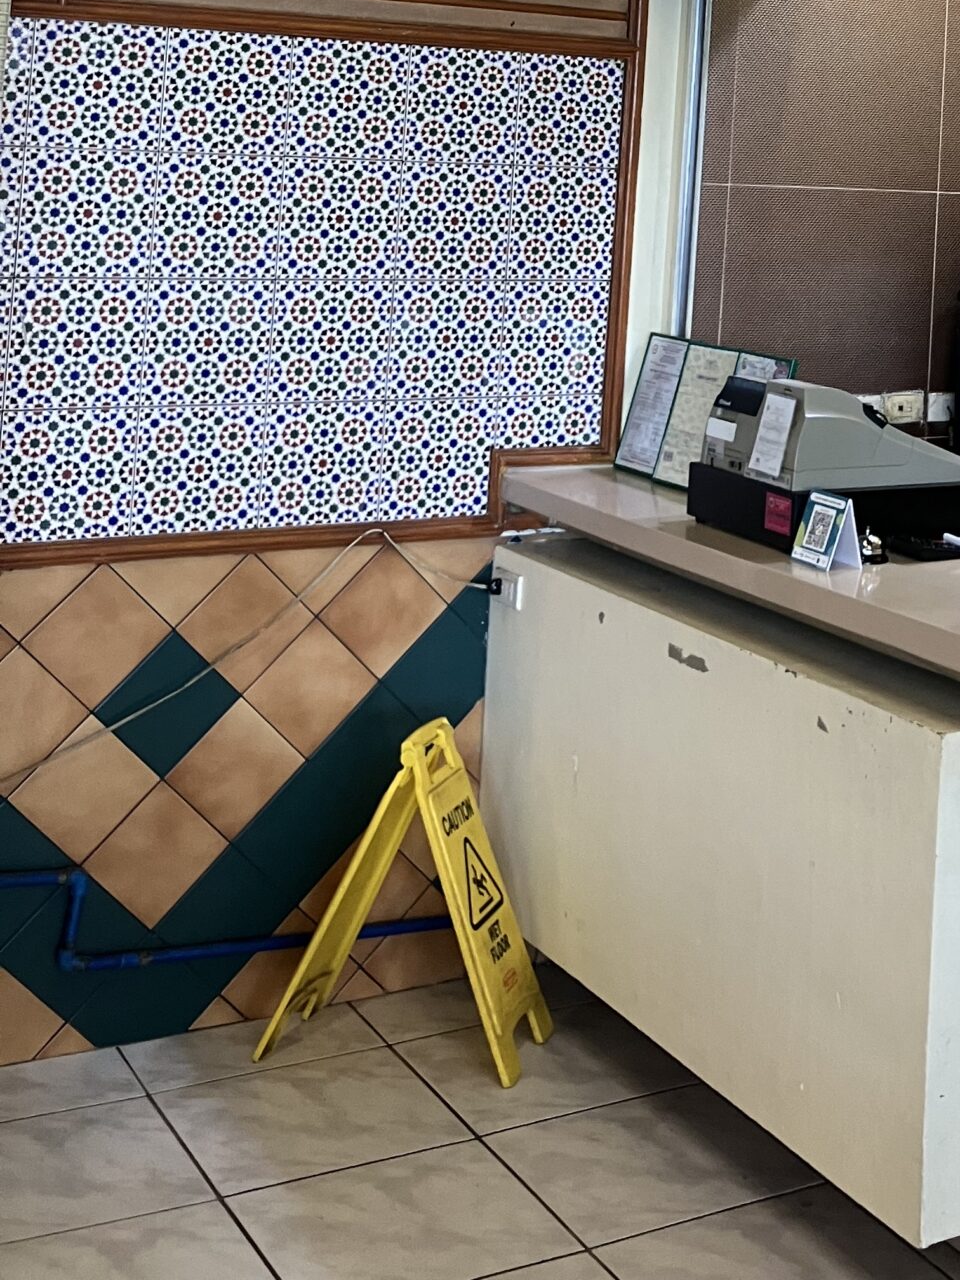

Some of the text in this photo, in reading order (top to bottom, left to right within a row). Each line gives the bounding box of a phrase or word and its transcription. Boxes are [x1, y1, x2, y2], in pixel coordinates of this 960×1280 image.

[441, 796, 475, 837] CAUTION
[487, 919, 502, 943] WET
[489, 933, 511, 965] FLOOR
